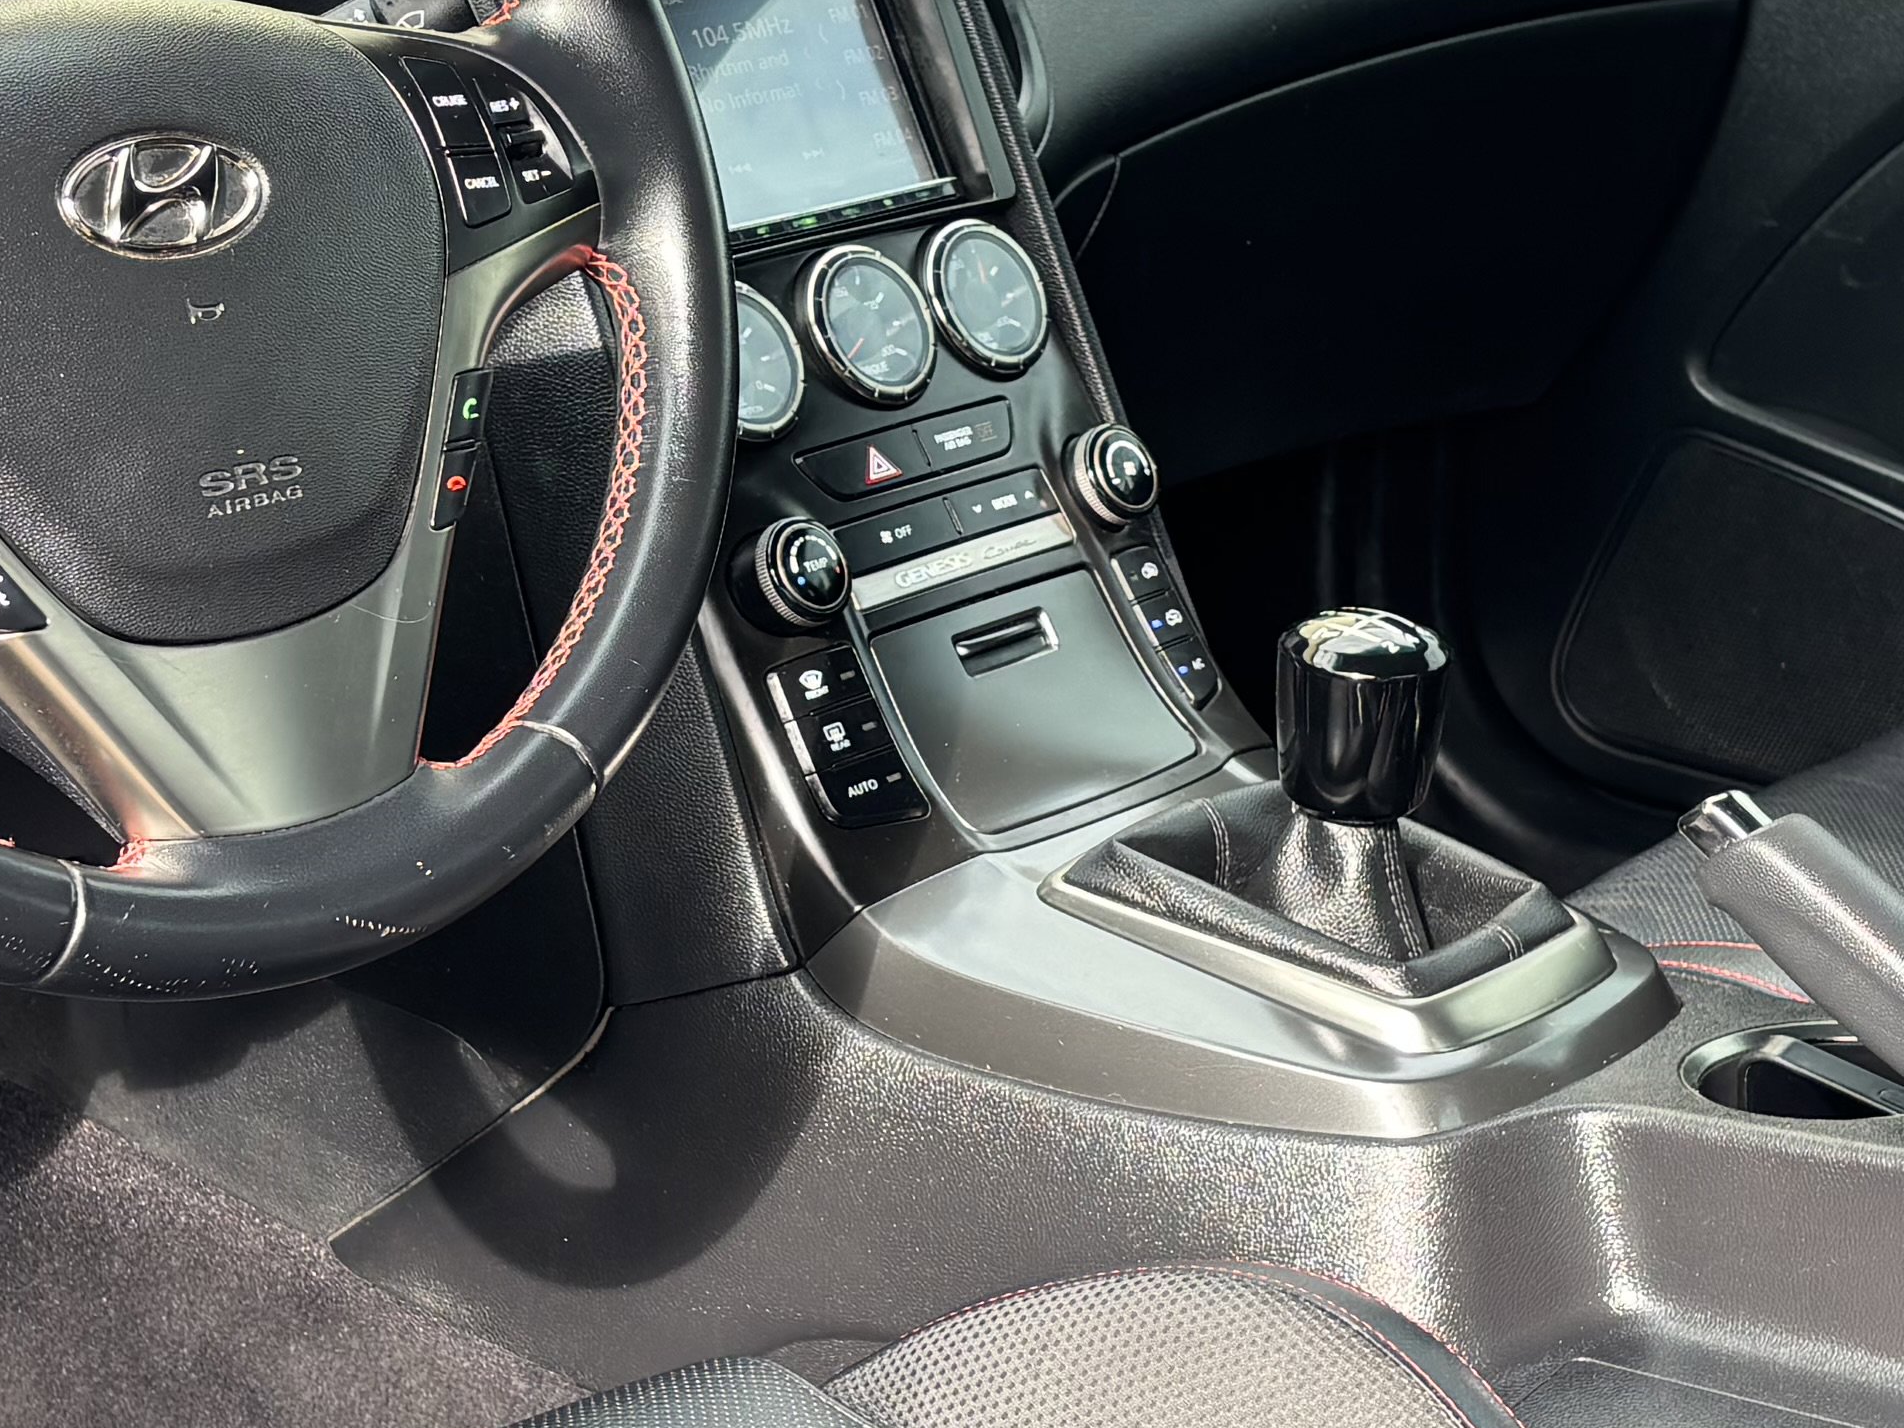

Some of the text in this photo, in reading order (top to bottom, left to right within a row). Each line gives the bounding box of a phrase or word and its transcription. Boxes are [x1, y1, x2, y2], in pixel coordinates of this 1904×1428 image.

[199, 456, 302, 497] SRS
[207, 485, 303, 518] AIRBAG
[894, 524, 913, 540] OFF
[803, 556, 828, 573] TEMP
[894, 552, 972, 589] GENESIS
[847, 778, 879, 798] AUTO
